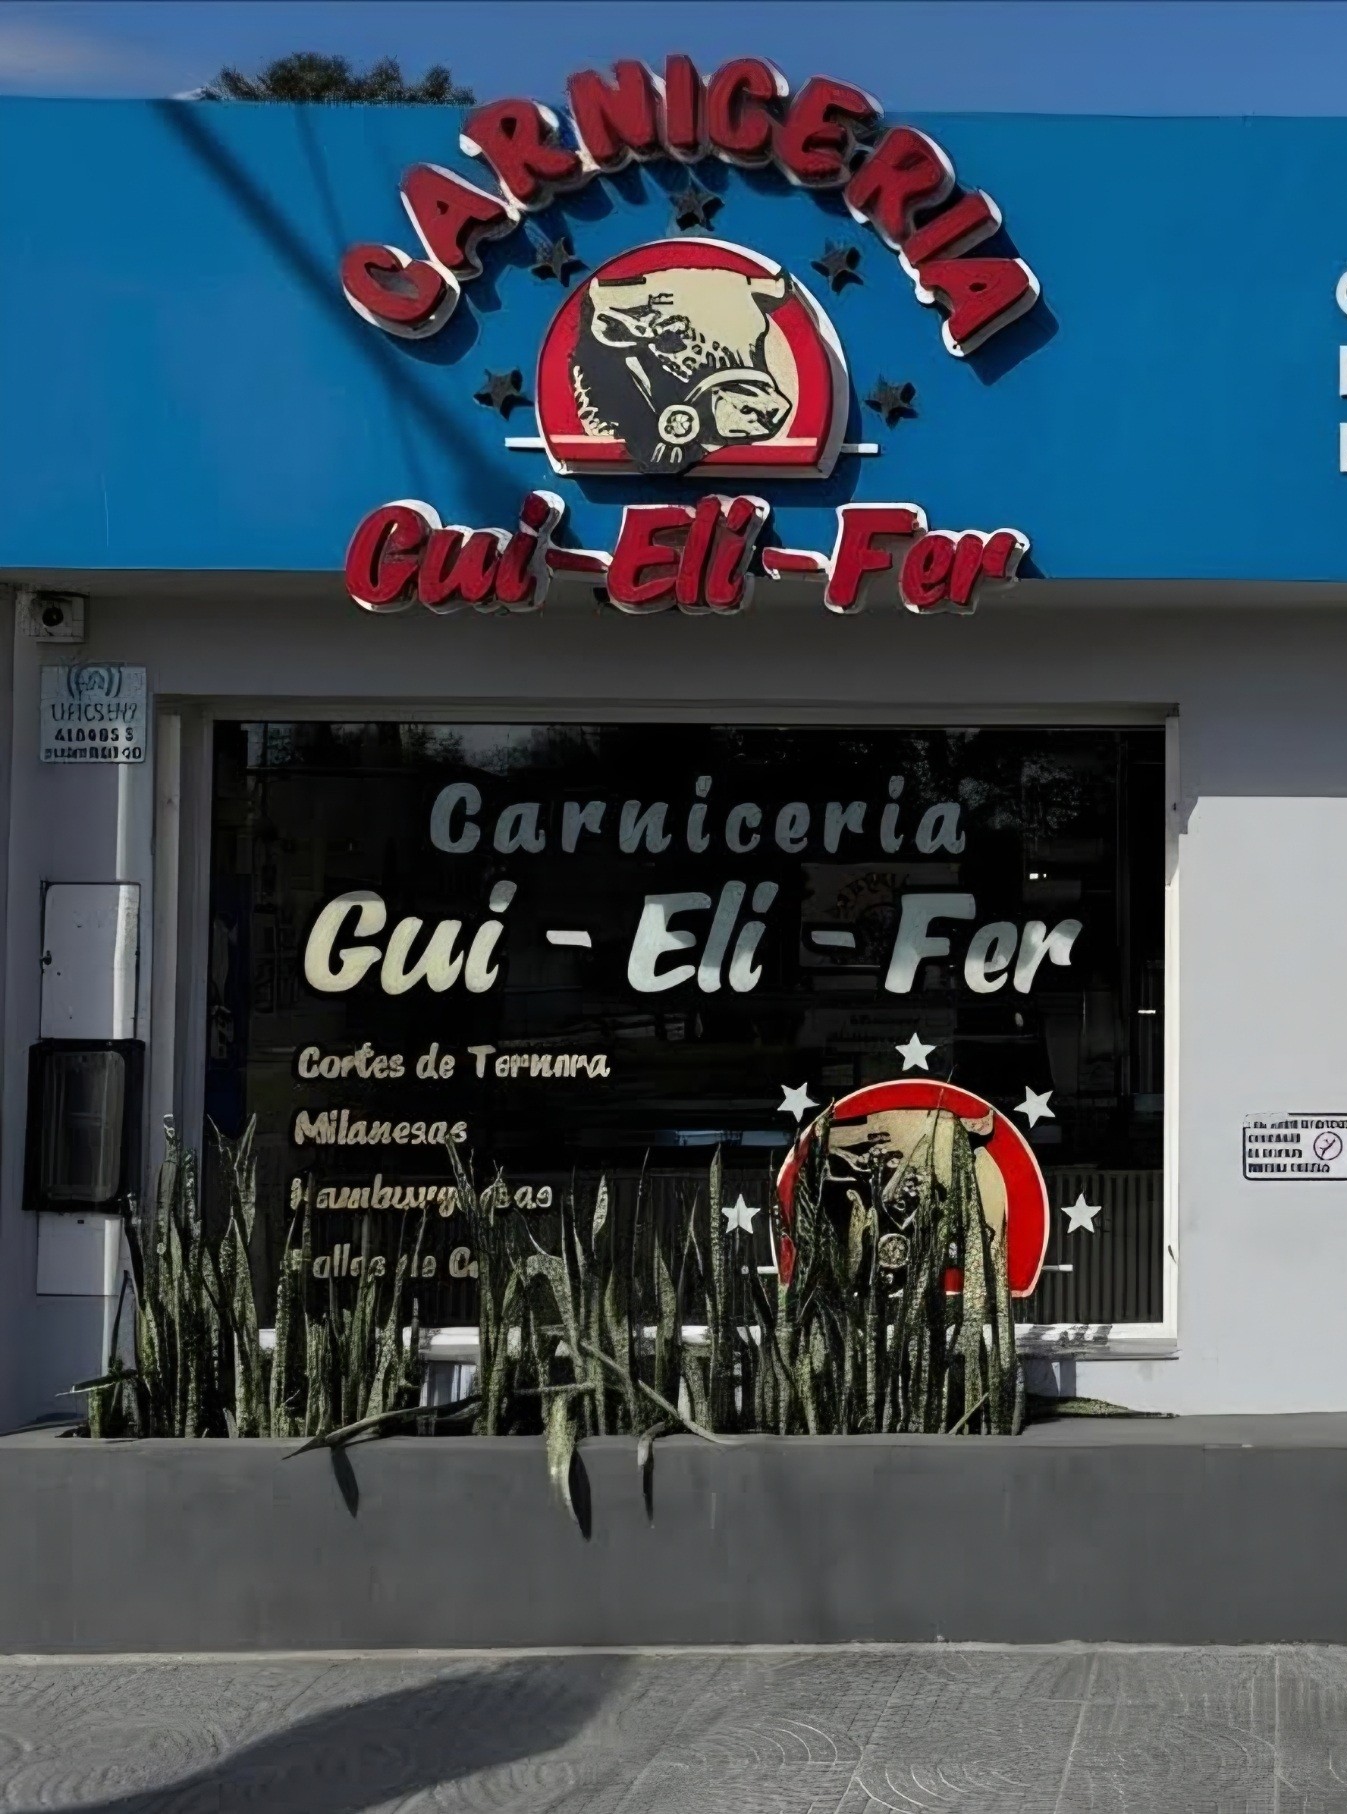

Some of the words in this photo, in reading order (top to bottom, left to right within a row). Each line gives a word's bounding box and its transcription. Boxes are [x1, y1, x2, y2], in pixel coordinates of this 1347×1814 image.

[342, 53, 1041, 357] CARNICERIA
[430, 775, 966, 854] Carniceria
[304, 881, 517, 994] Gui
[627, 881, 779, 993] Eli
[885, 893, 1083, 994] Fer
[297, 1041, 405, 1079] Cortes
[415, 1041, 456, 1079] de
